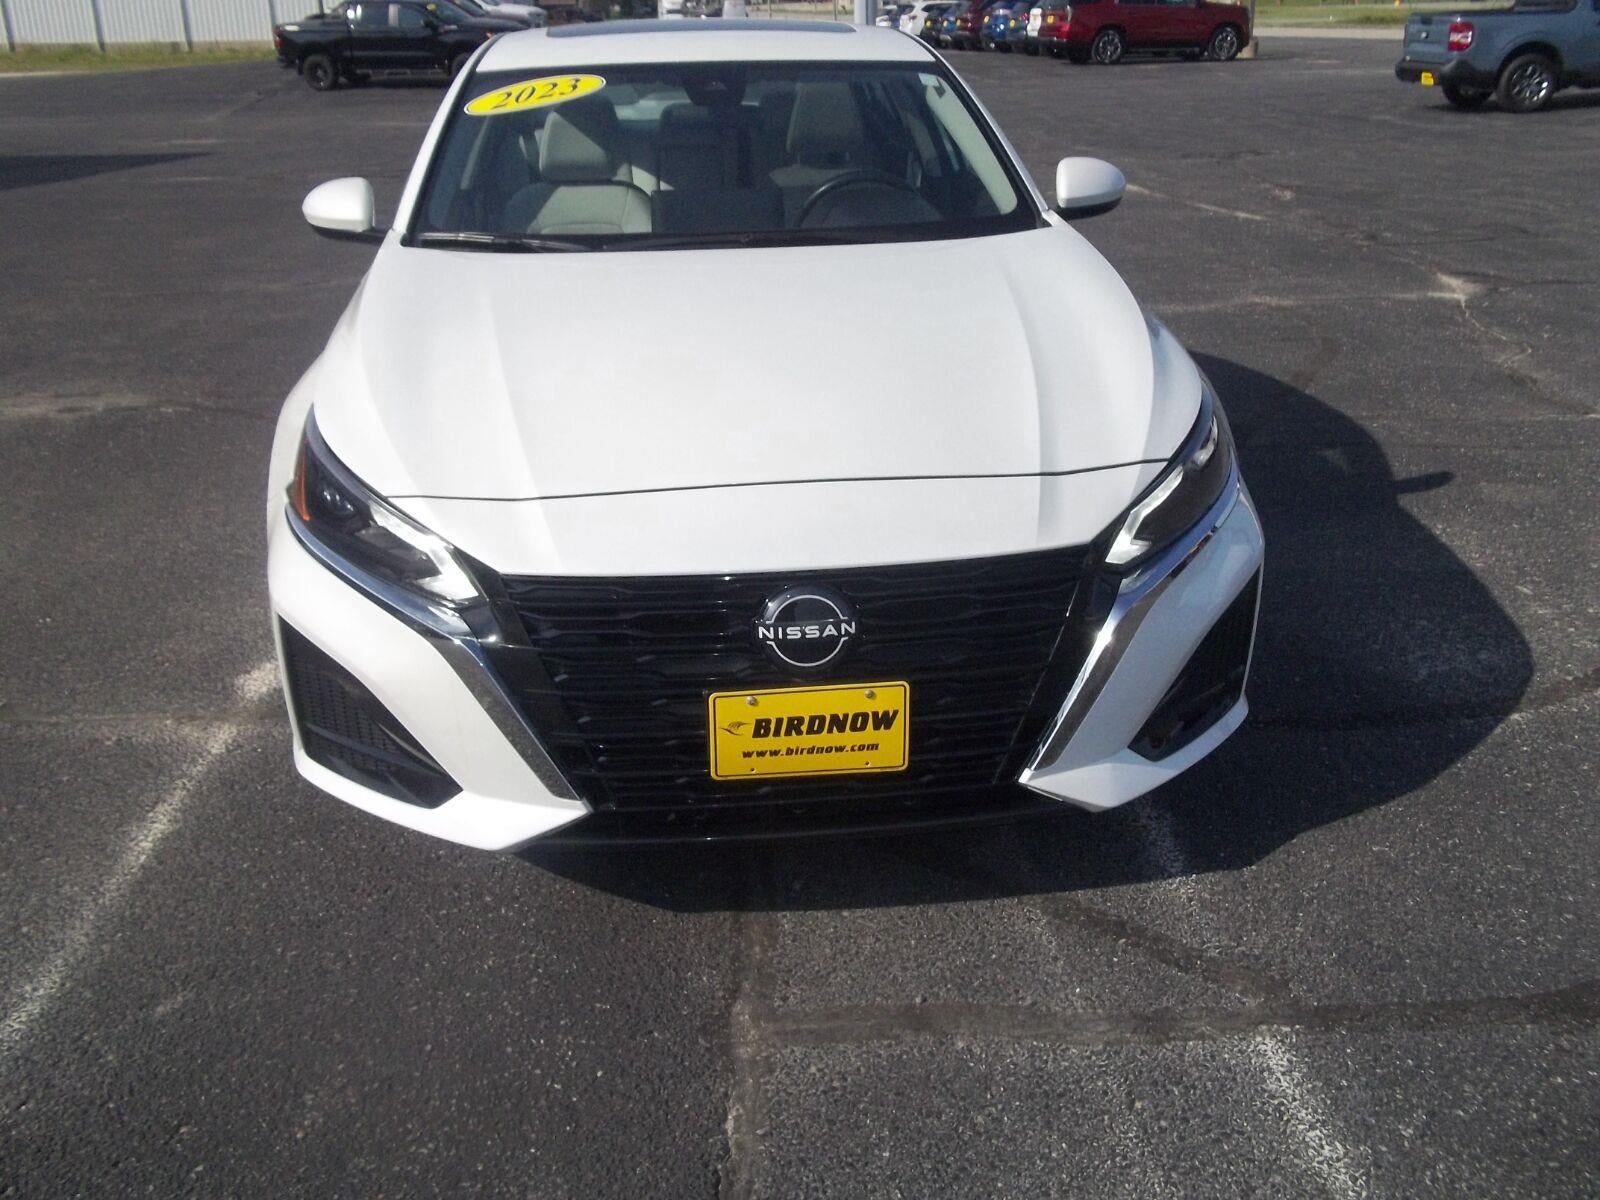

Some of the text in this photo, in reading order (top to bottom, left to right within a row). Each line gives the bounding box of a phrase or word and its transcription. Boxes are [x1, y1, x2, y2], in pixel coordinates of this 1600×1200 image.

[491, 79, 581, 109] 2023
[758, 621, 856, 640] NISSAN
[753, 710, 899, 738] BIRDNOW
[742, 742, 880, 759] www.birdnow.com
